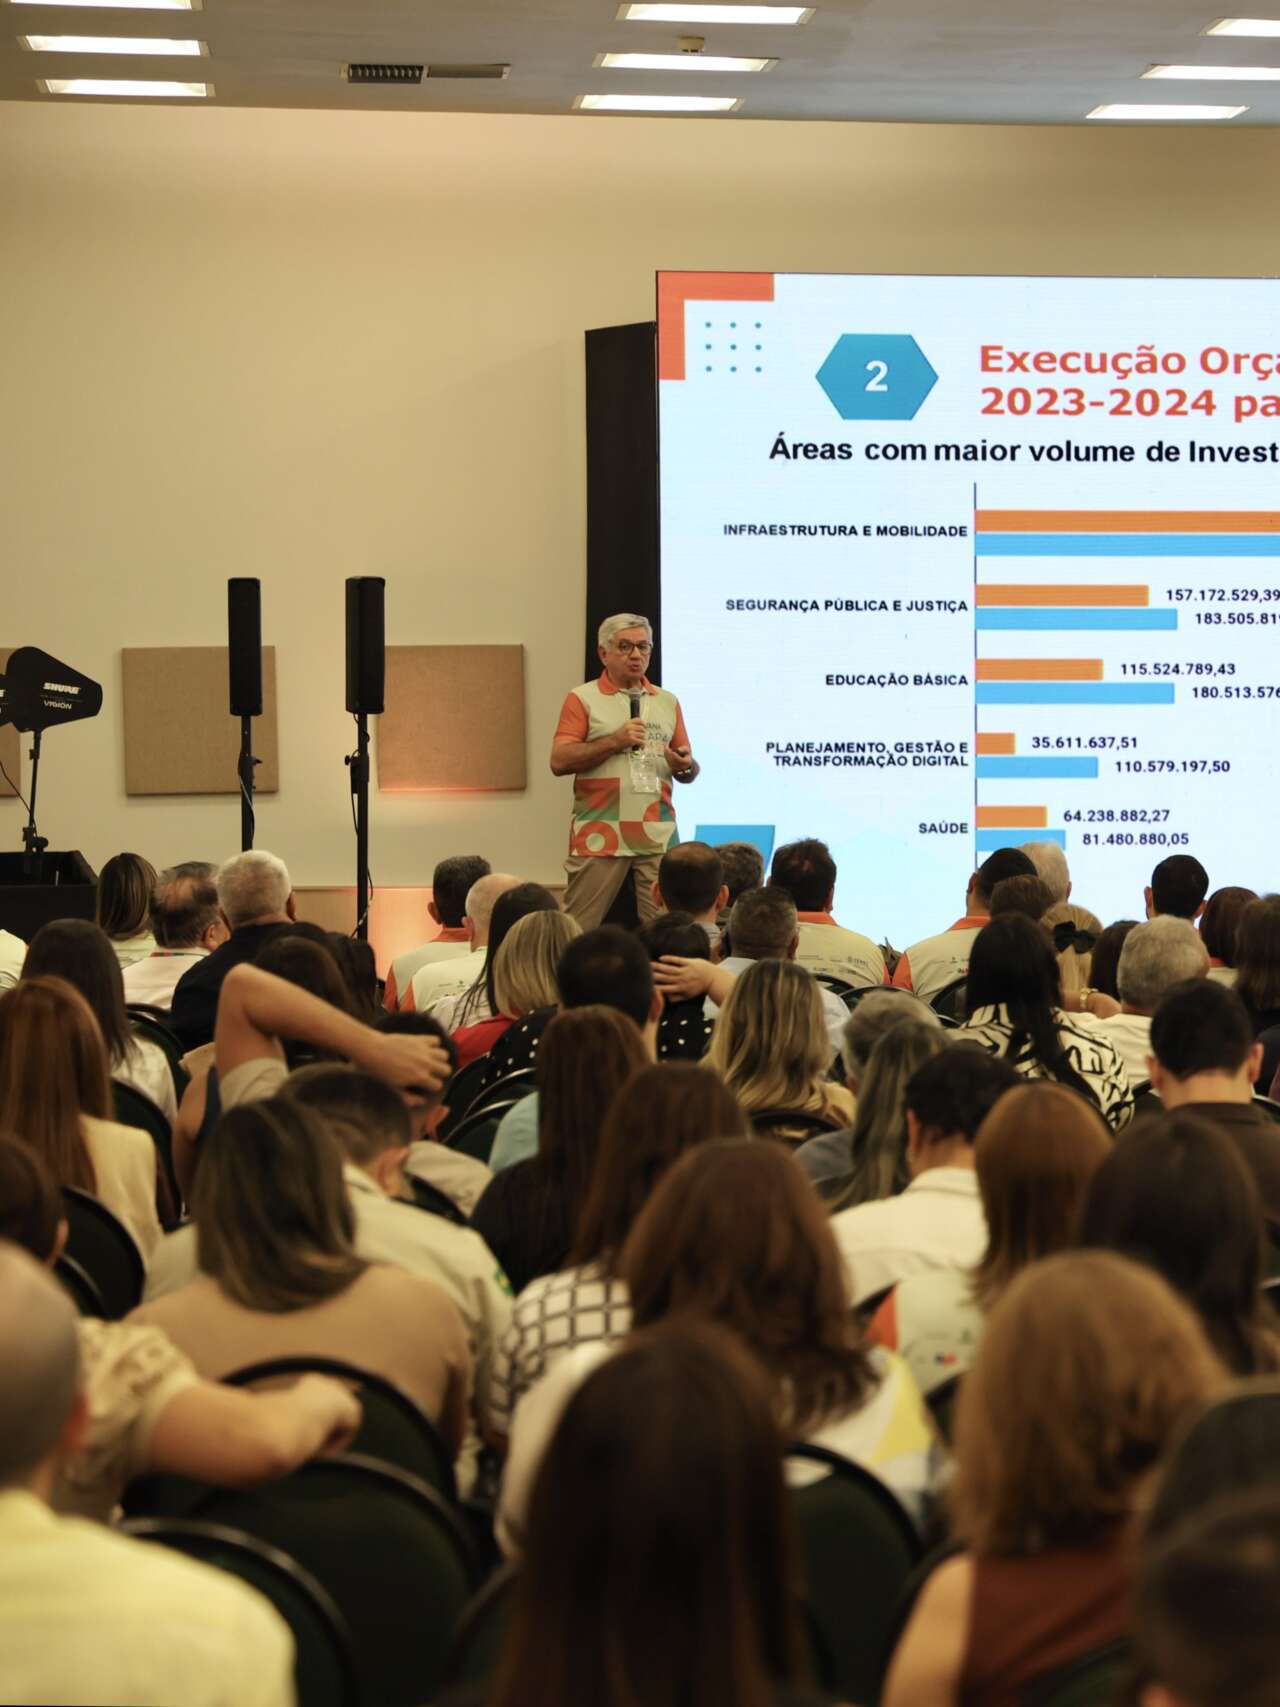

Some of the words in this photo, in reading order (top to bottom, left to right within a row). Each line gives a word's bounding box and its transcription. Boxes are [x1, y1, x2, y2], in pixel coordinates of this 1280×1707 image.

[980, 344, 1187, 380] Execução
[865, 360, 888, 392] 2
[981, 386, 1217, 417] 2023-2024
[768, 431, 853, 461] Áreas
[864, 443, 927, 461] com
[934, 438, 1022, 462] maior
[1028, 439, 1136, 463] volume
[1145, 439, 1181, 463] de
[723, 524, 859, 537] INFRAESTRUTURA
[862, 525, 872, 537] E
[876, 525, 968, 537] MOBILIDADE
[725, 599, 820, 614] SEGURANÇA
[824, 597, 889, 612] PÚBLICA
[892, 600, 902, 612] E
[905, 600, 969, 614] JUSTIÇA
[1121, 662, 1236, 677] 115.524.789,43
[825, 672, 910, 688] EDUCAÇÃO
[912, 671, 969, 686] BÁSICA
[43, 682, 80, 694] SHURE
[766, 742, 891, 754] PLANEJAMENTO,
[894, 740, 956, 753] GESTÃO
[959, 742, 968, 753] E
[1031, 736, 1137, 751] 35.611.637,51
[773, 754, 908, 769] TRANSFORMAÇÃO
[912, 755, 969, 767] DIGITAL
[1115, 760, 1231, 775] 110.579.197,50
[1063, 809, 1170, 824] 64.238.882,27
[918, 820, 969, 834] SAÚDE
[1082, 832, 1190, 847] 81.480.880,05
